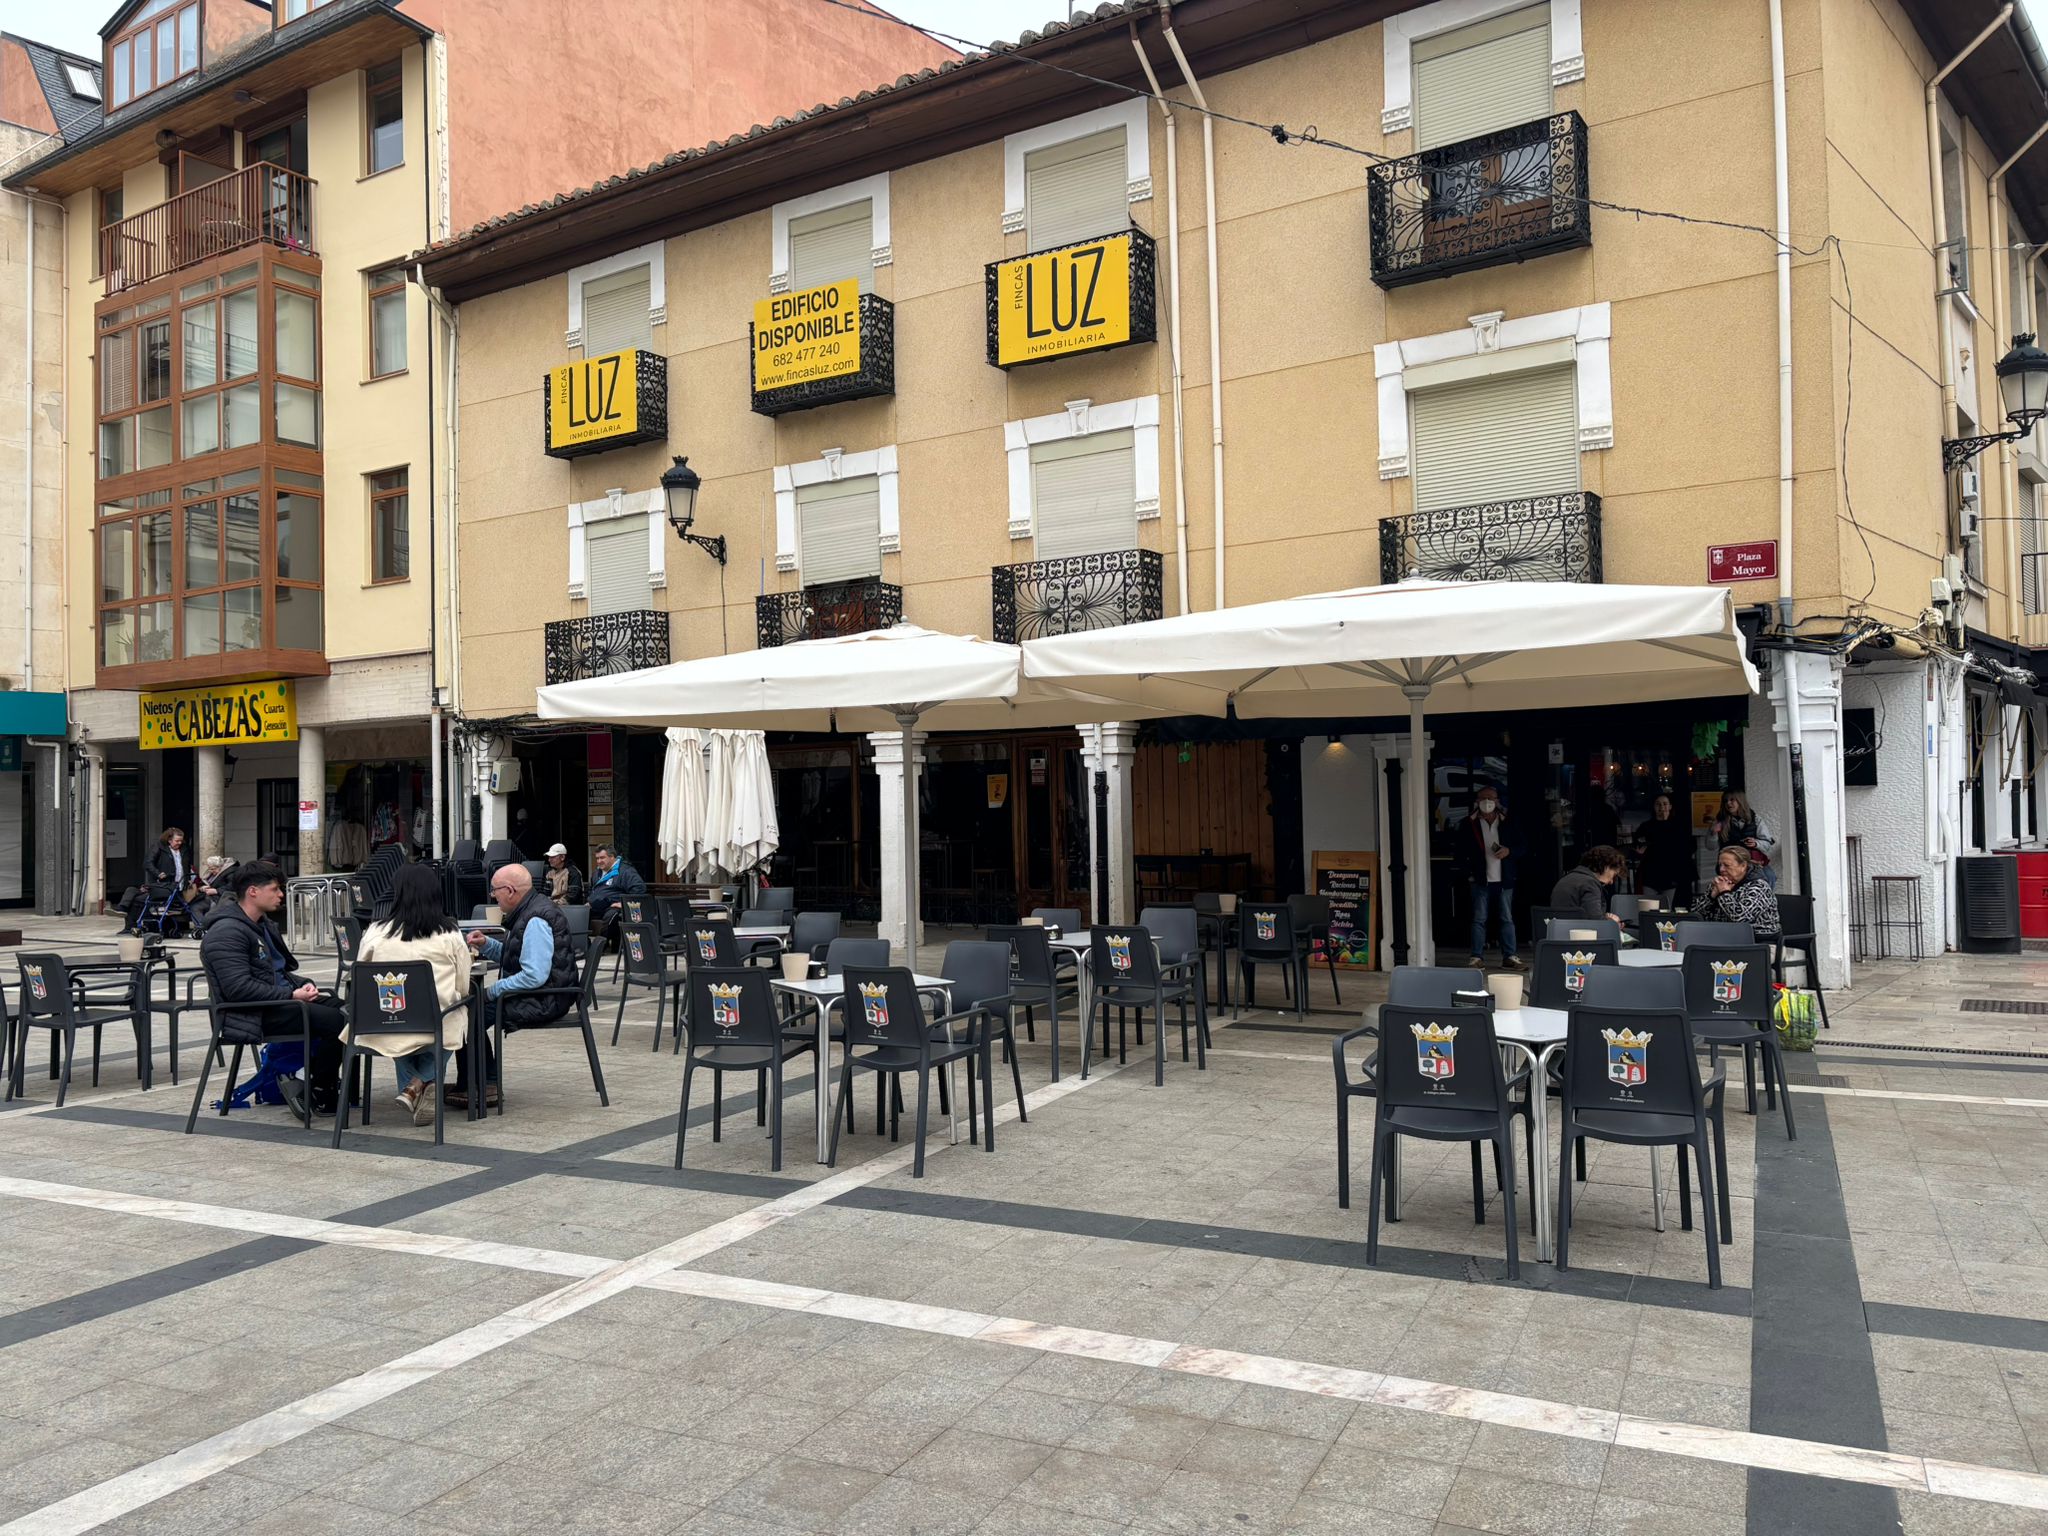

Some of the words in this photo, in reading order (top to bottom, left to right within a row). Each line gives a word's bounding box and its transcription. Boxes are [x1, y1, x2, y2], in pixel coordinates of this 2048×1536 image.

[1014, 265, 1024, 309] FINCAS
[1026, 246, 1106, 338] LUZ
[771, 287, 839, 322] EDIFICIO
[759, 311, 855, 351] DISPONIBLE
[1027, 332, 1106, 354] INMOBILIARIA
[772, 352, 793, 367] 682
[795, 346, 816, 361] 477
[819, 341, 840, 357] 240
[761, 359, 854, 386] www.fincasluz.com
[560, 368, 568, 404] FINCAS
[568, 355, 622, 428] LUZ
[569, 424, 622, 440] INMOBILIARIA
[1737, 552, 1762, 561] Plaza
[1732, 565, 1767, 576] Mayor
[143, 701, 173, 716] Nietos
[174, 694, 262, 741] CABEZAS
[263, 703, 285, 714] Cuarta
[160, 718, 172, 733] de
